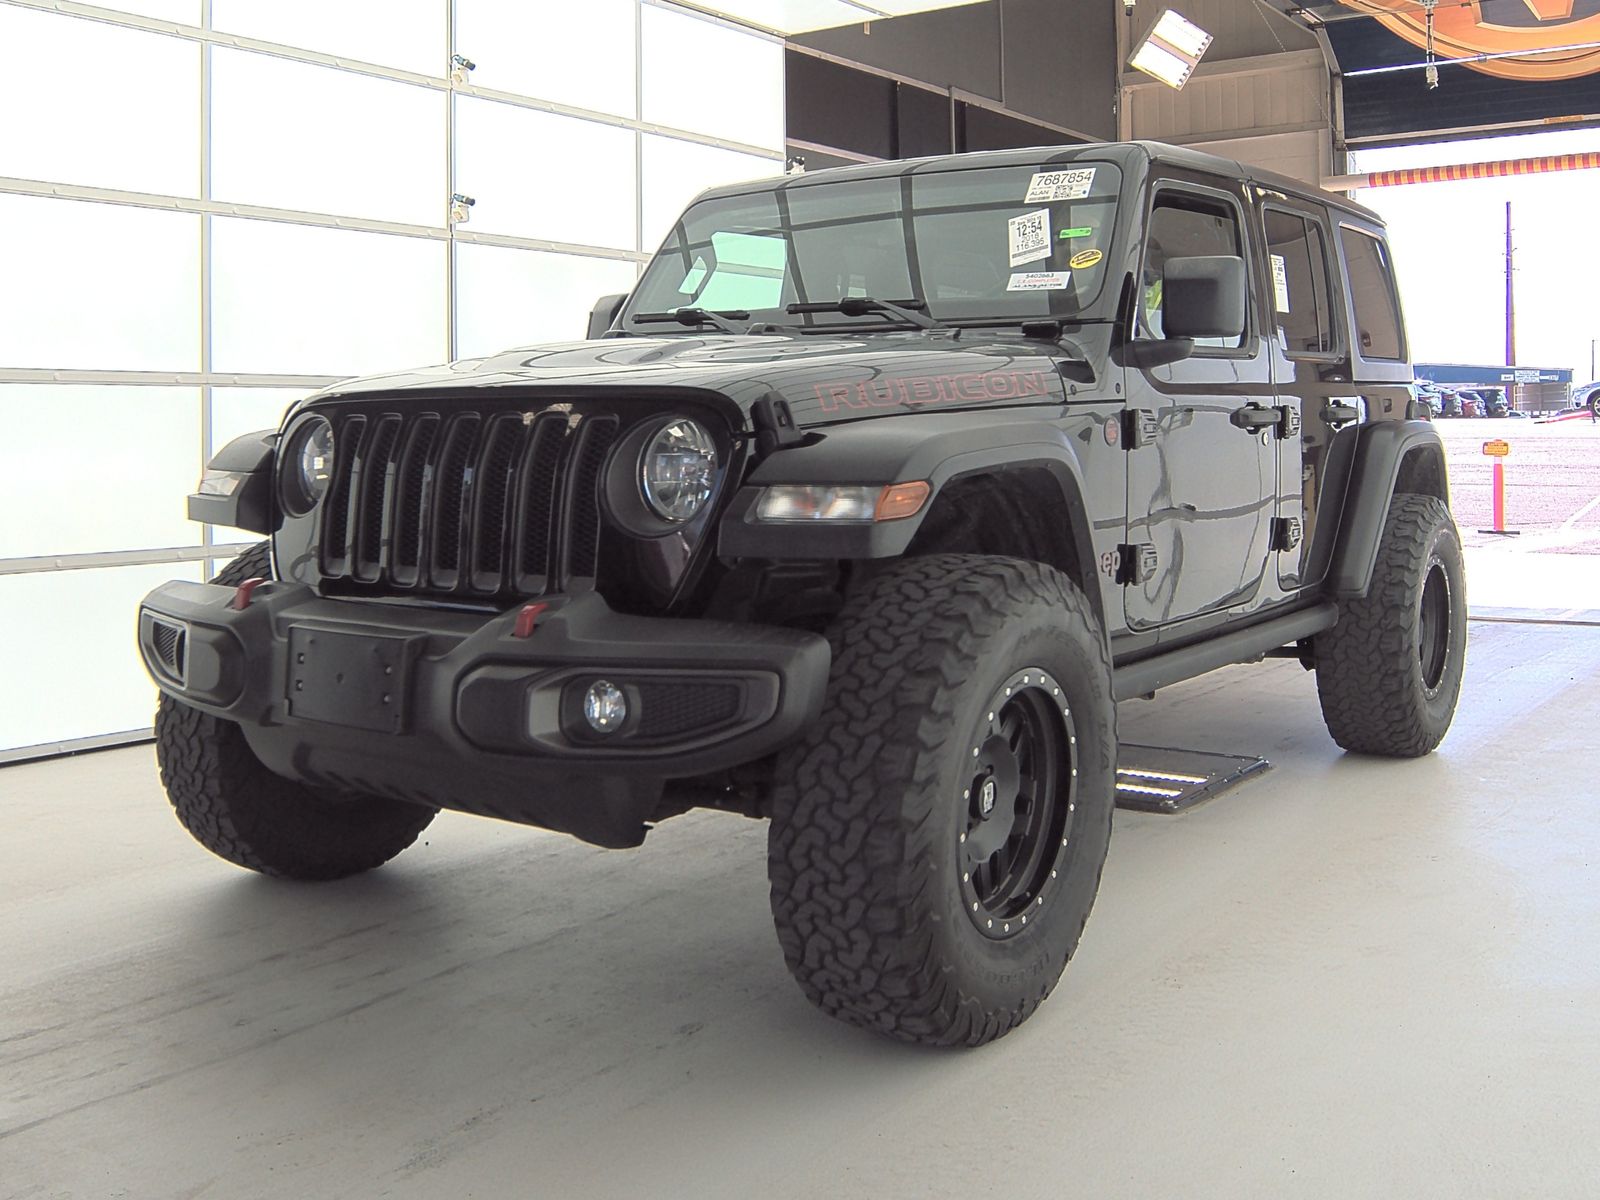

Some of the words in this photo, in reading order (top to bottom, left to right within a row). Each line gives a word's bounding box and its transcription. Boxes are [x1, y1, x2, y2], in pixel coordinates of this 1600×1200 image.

[1037, 171, 1092, 186] 7687854
[1017, 219, 1042, 238] 12:54
[813, 371, 1048, 412] RUBICON
[1101, 551, 1121, 577] ep
